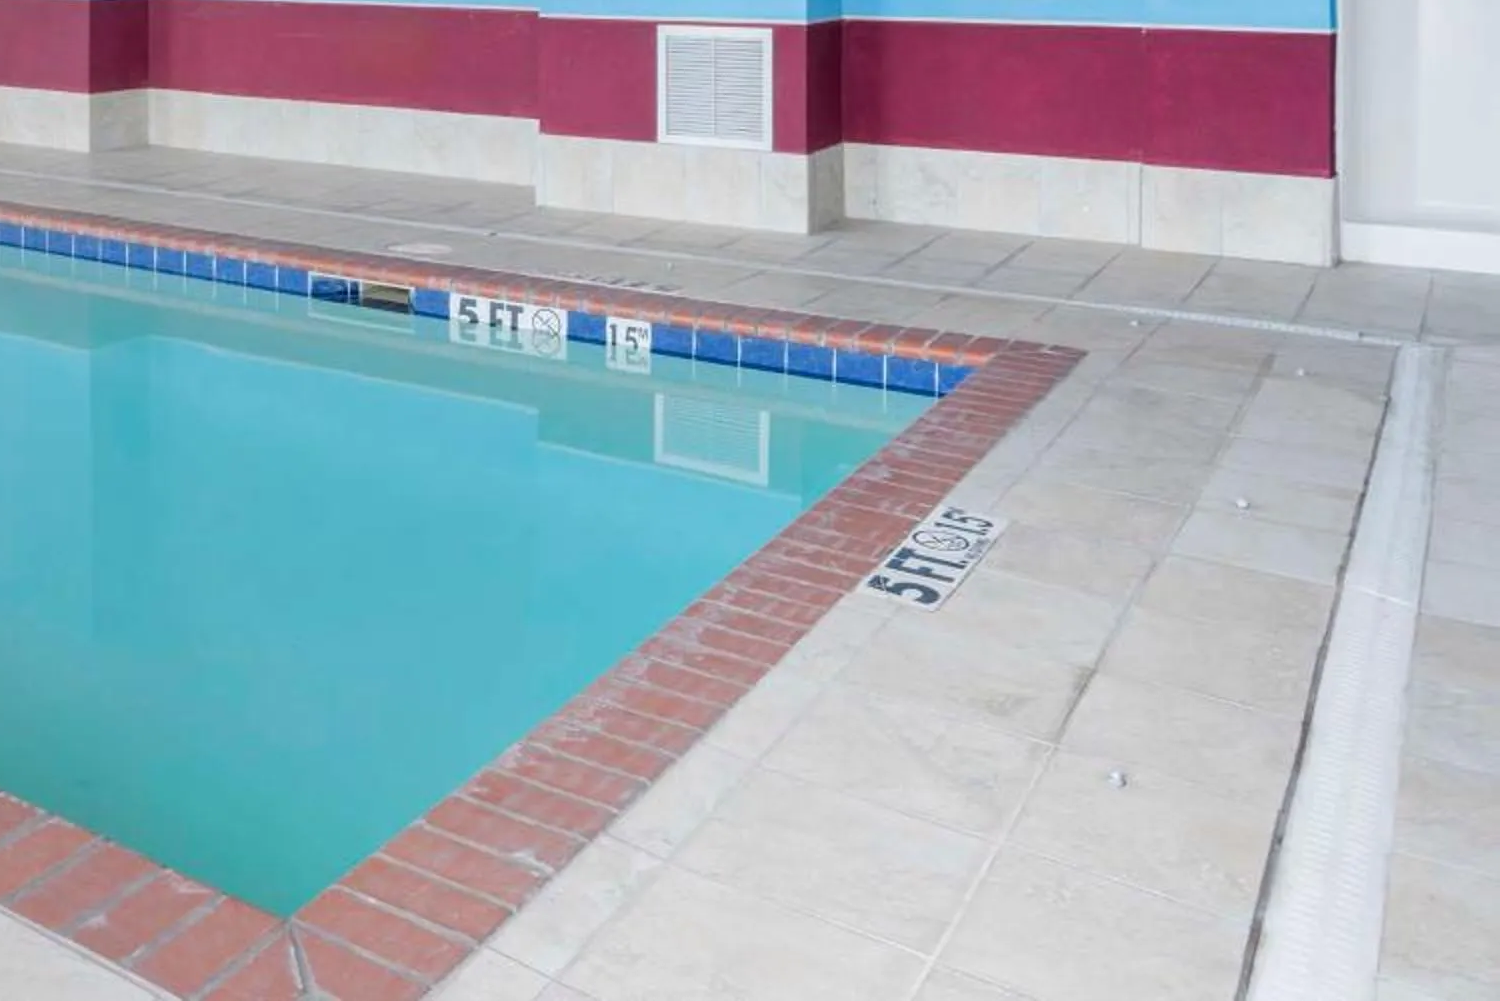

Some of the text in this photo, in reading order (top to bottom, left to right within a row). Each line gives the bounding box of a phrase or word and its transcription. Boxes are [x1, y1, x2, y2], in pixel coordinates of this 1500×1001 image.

[459, 297, 524, 331] 5 FT
[867, 574, 941, 604] 5
